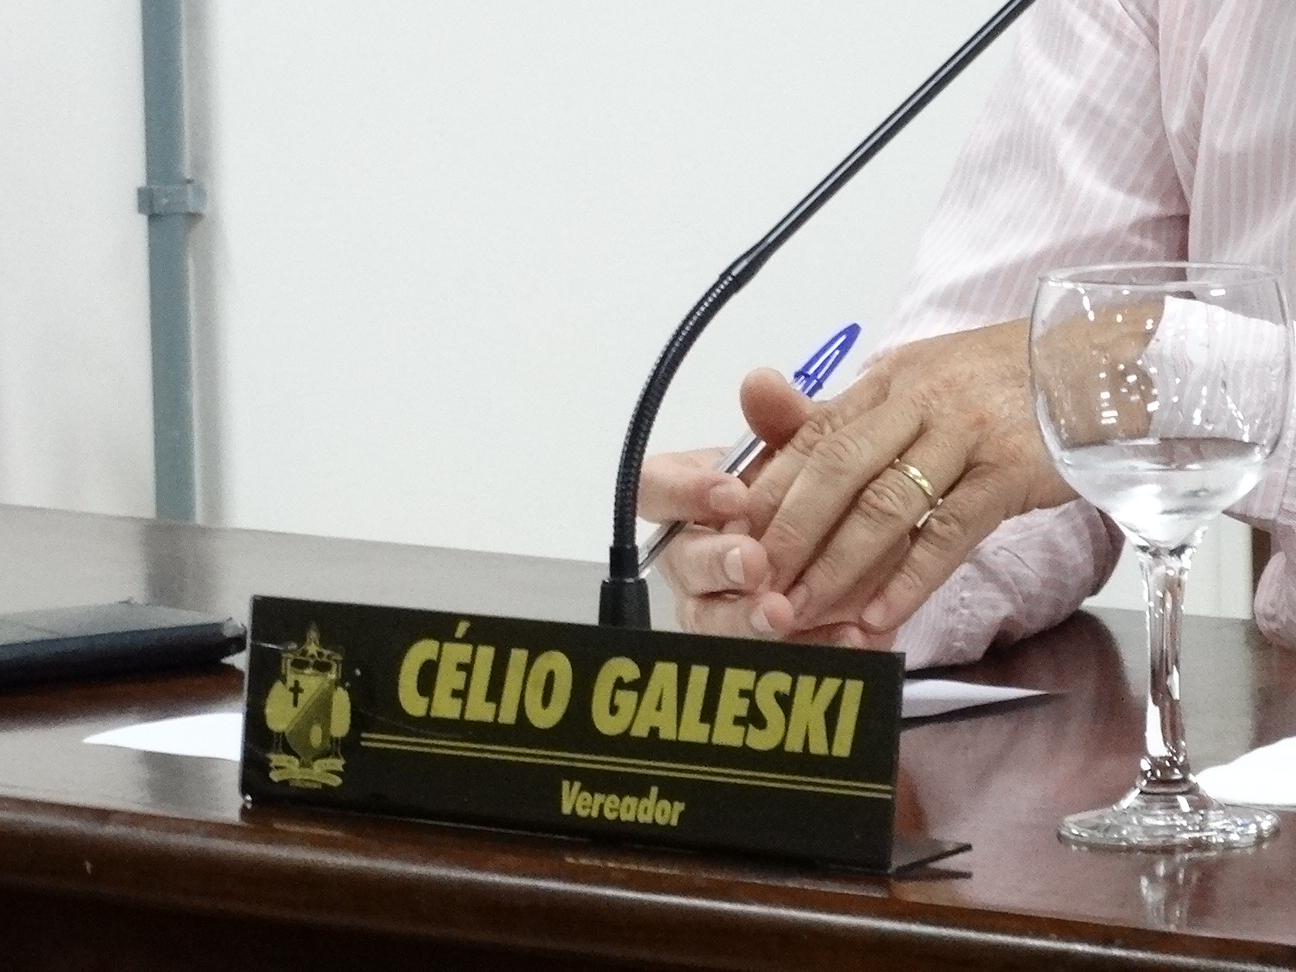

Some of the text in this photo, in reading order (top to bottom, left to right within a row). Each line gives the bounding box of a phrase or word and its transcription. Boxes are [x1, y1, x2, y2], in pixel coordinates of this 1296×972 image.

[399, 620, 865, 758] CÉLIO GALESKI
[560, 780, 686, 827] Vereador
